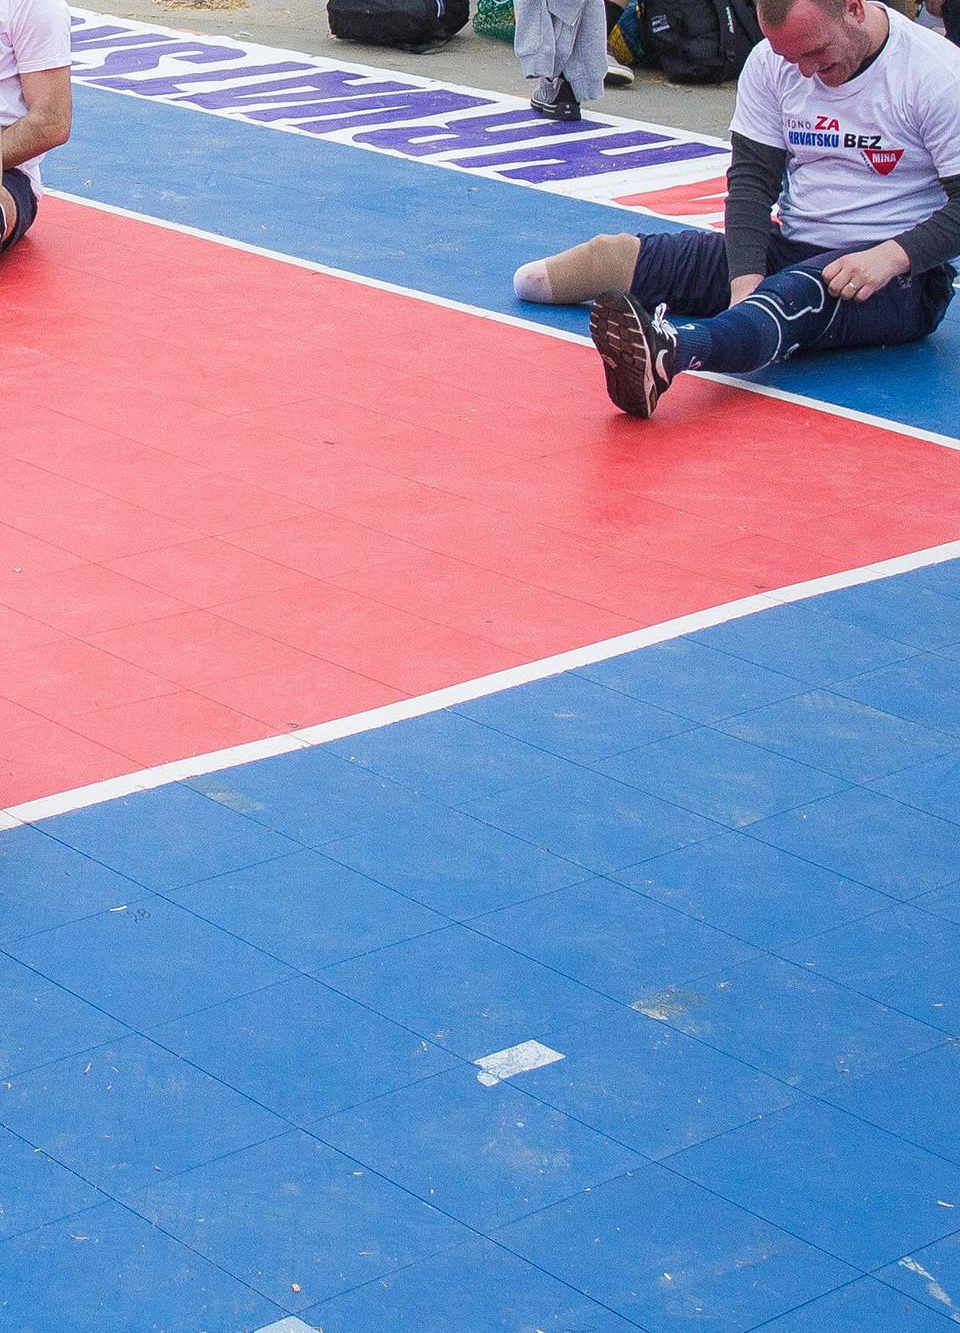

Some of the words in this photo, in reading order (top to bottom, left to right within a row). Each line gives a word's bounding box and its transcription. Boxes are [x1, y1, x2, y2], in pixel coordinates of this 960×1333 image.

[815, 116, 840, 131] ZA
[788, 131, 839, 148] HRVATSKU
[843, 133, 882, 149] BEZ
[872, 153, 896, 163] MINA
